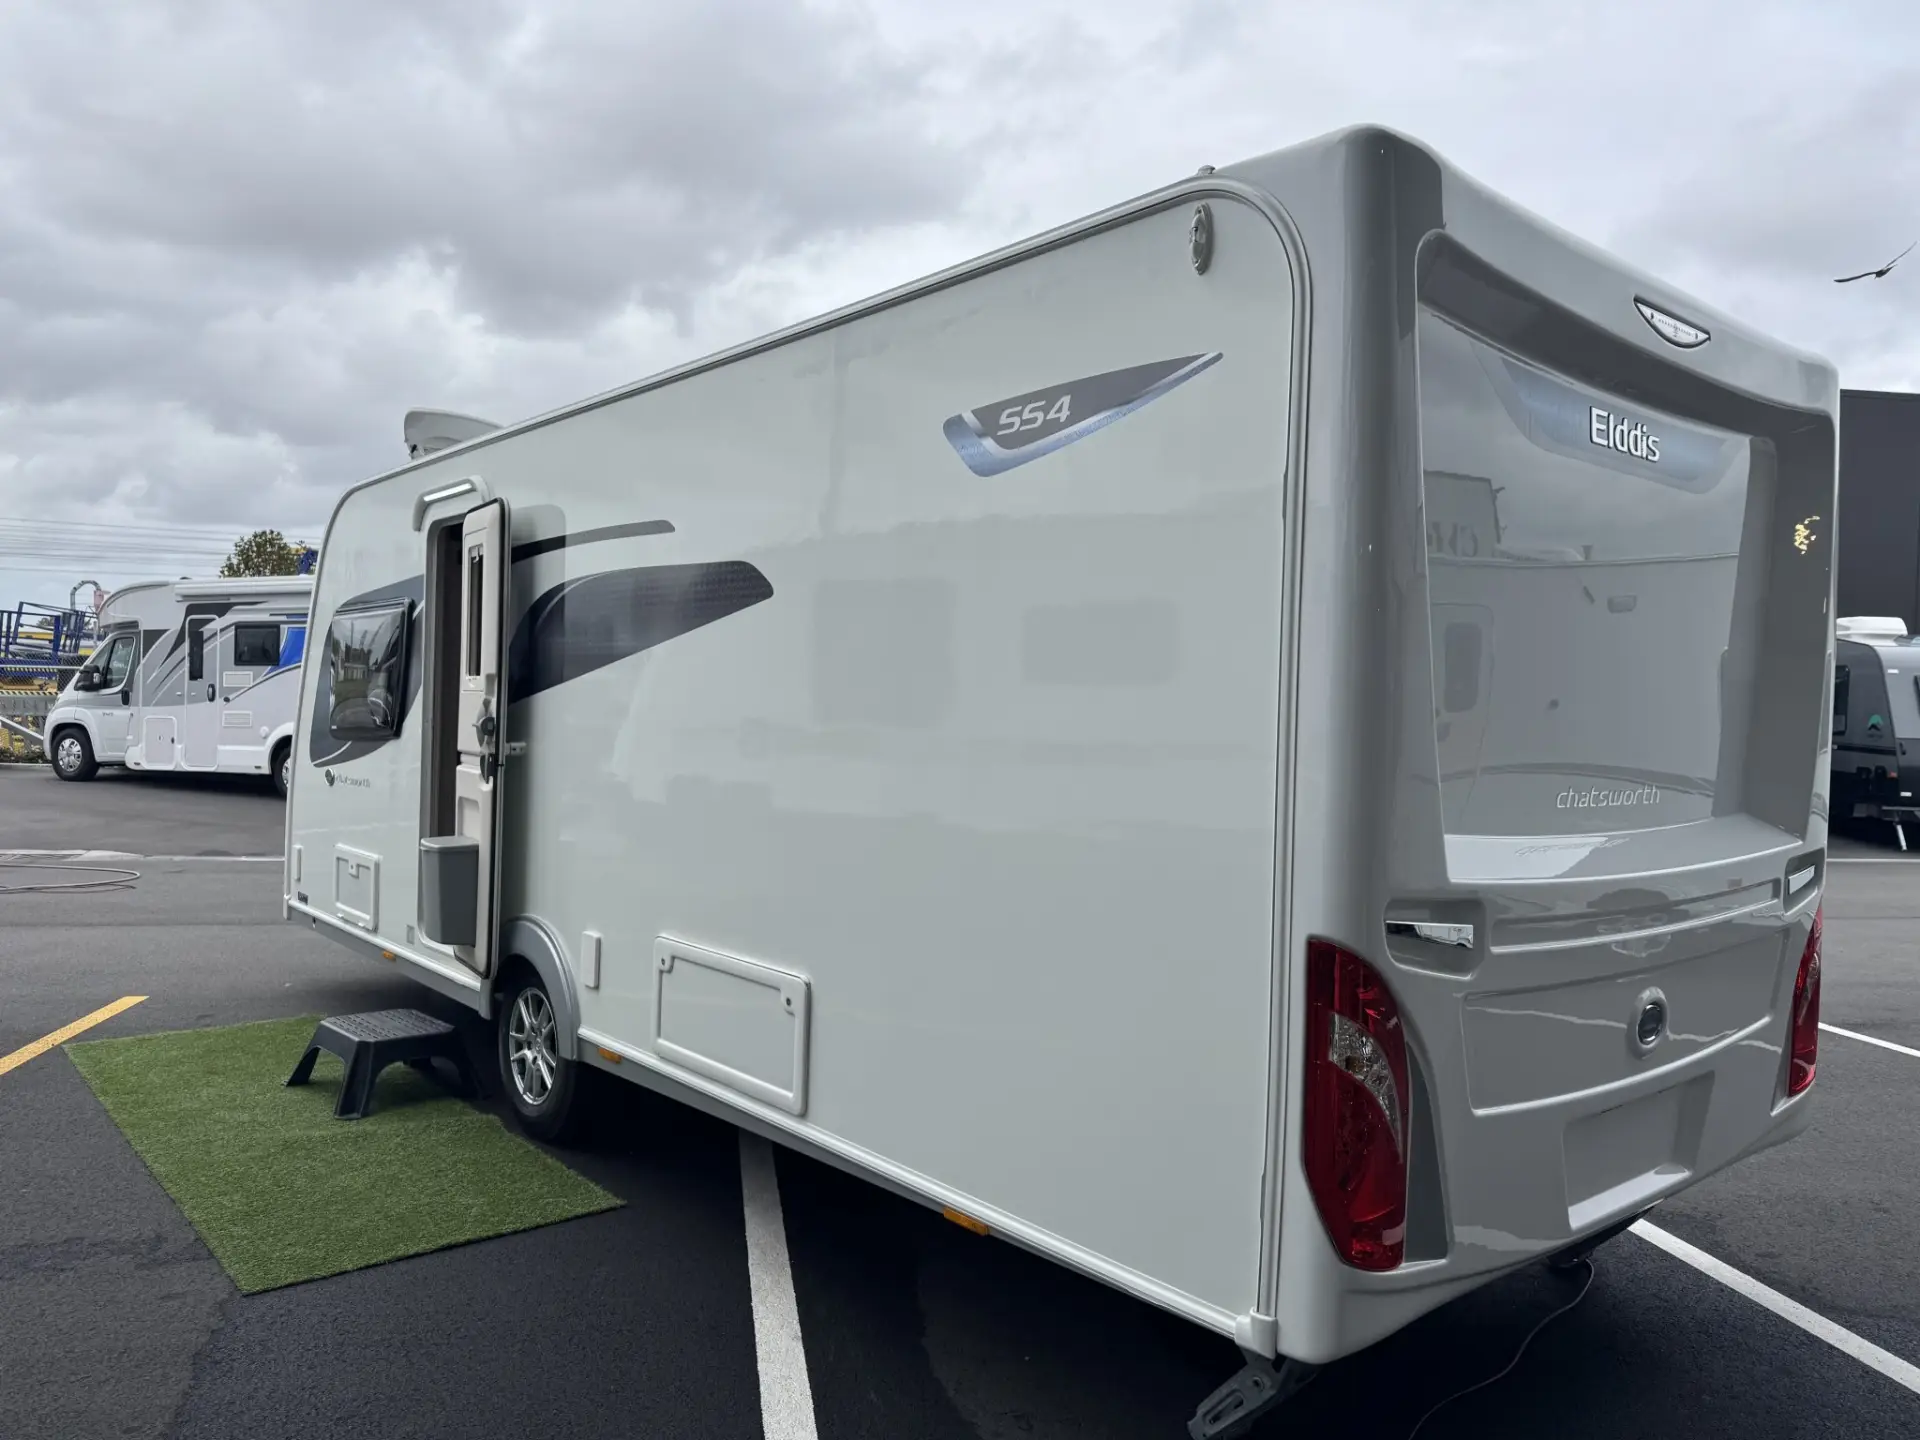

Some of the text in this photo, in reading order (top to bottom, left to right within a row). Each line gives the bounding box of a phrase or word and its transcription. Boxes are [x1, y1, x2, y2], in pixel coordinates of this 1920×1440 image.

[997, 394, 1071, 436] SS4
[1589, 405, 1660, 463] Elddis
[1556, 784, 1660, 808] chatsworth
